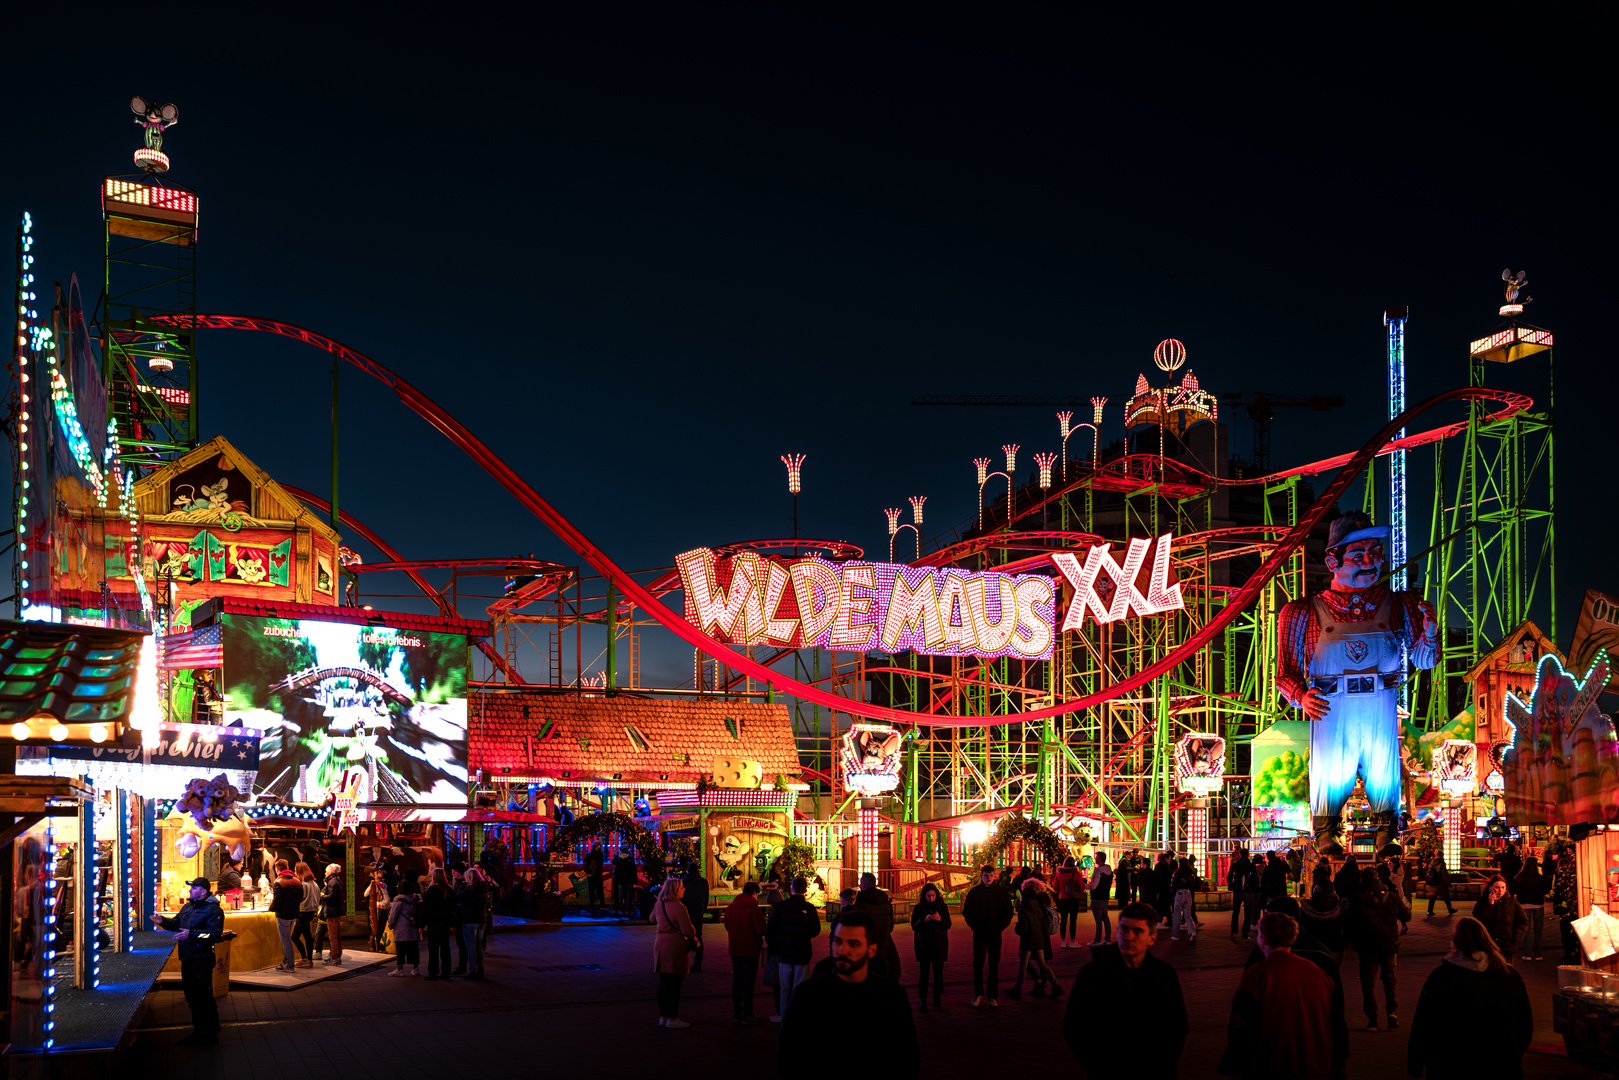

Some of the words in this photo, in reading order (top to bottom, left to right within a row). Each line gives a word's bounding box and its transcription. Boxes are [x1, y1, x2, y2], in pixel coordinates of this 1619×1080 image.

[683, 552, 876, 646] WILDE
[882, 571, 1053, 656] MAUS
[1050, 531, 1185, 633] XXL
[363, 632, 385, 645] tolles
[387, 635, 421, 647] Erlebnis
[336, 798, 353, 809] CORN
[343, 814, 359, 825] DOGS
[736, 819, 769, 829] EINGANG
